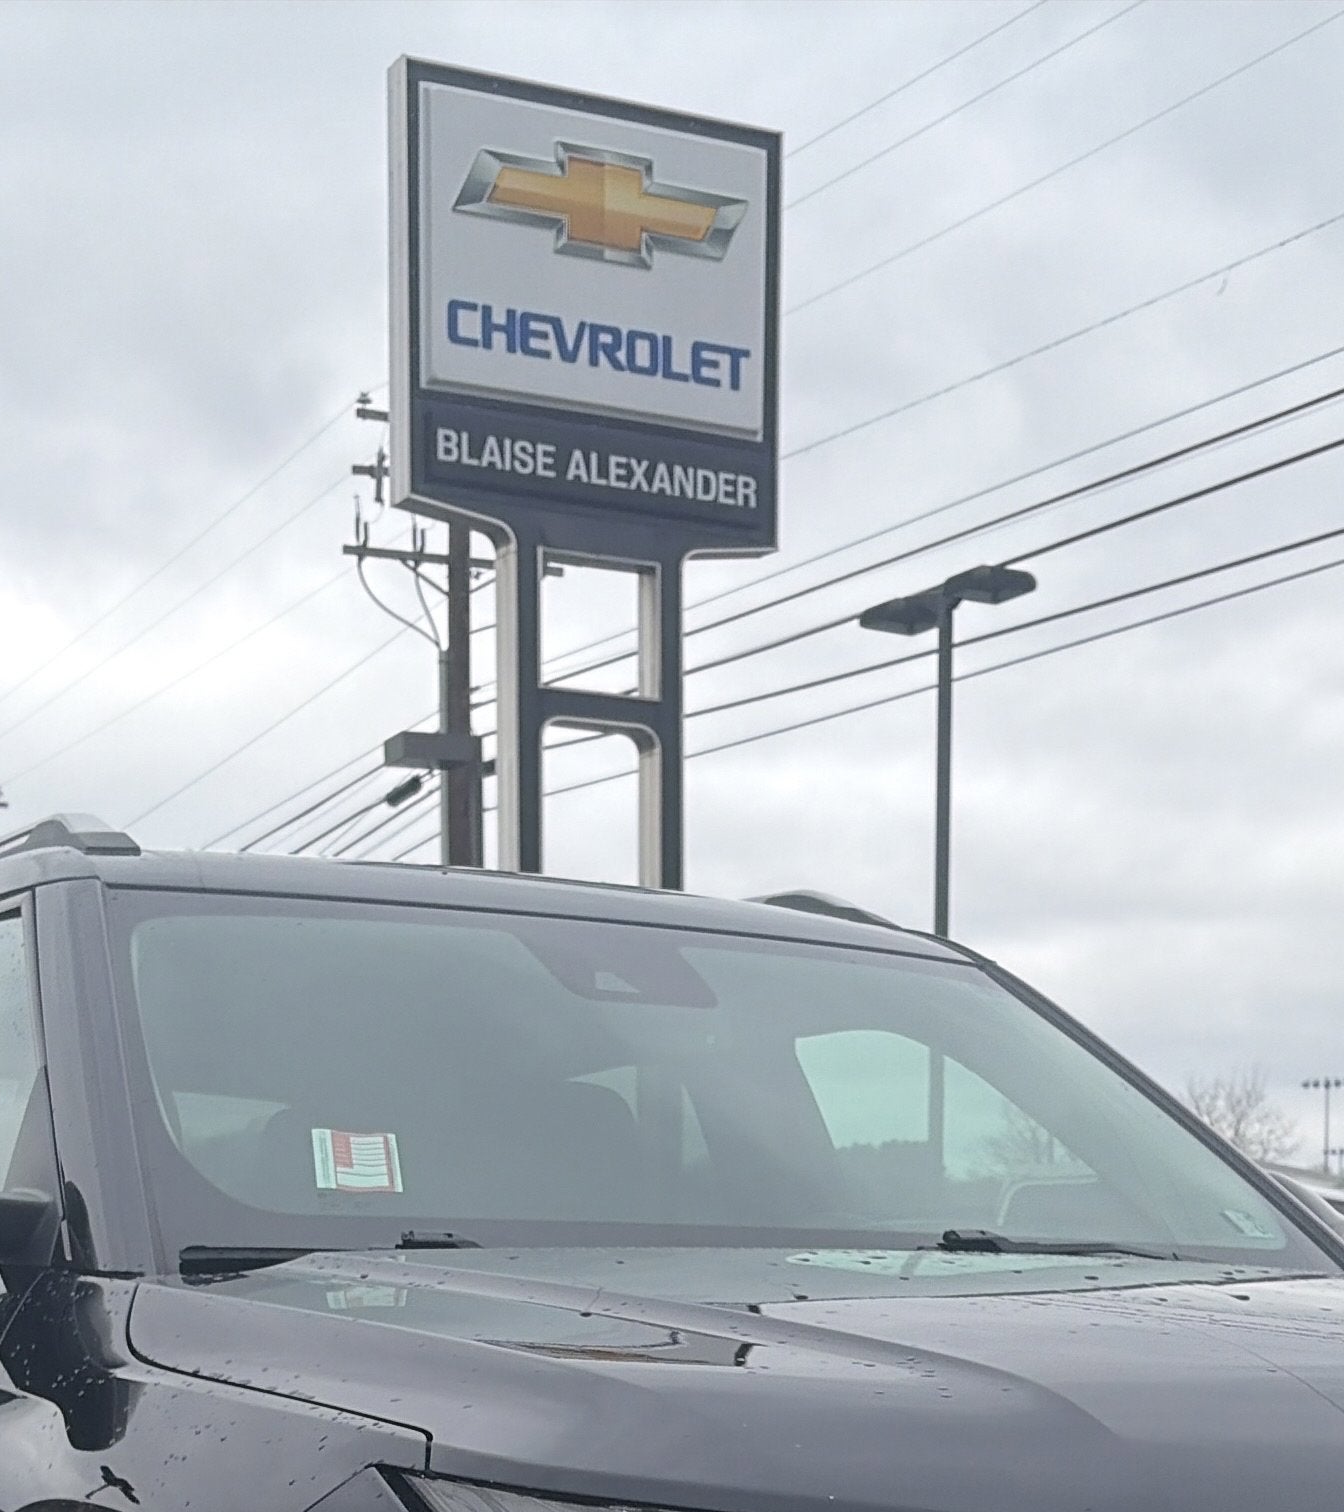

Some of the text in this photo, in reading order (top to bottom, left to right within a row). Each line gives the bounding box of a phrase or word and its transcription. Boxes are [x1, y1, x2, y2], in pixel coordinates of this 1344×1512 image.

[447, 299, 751, 392] CHEVROLET
[436, 427, 757, 508] BLAISE ALEXANDER
